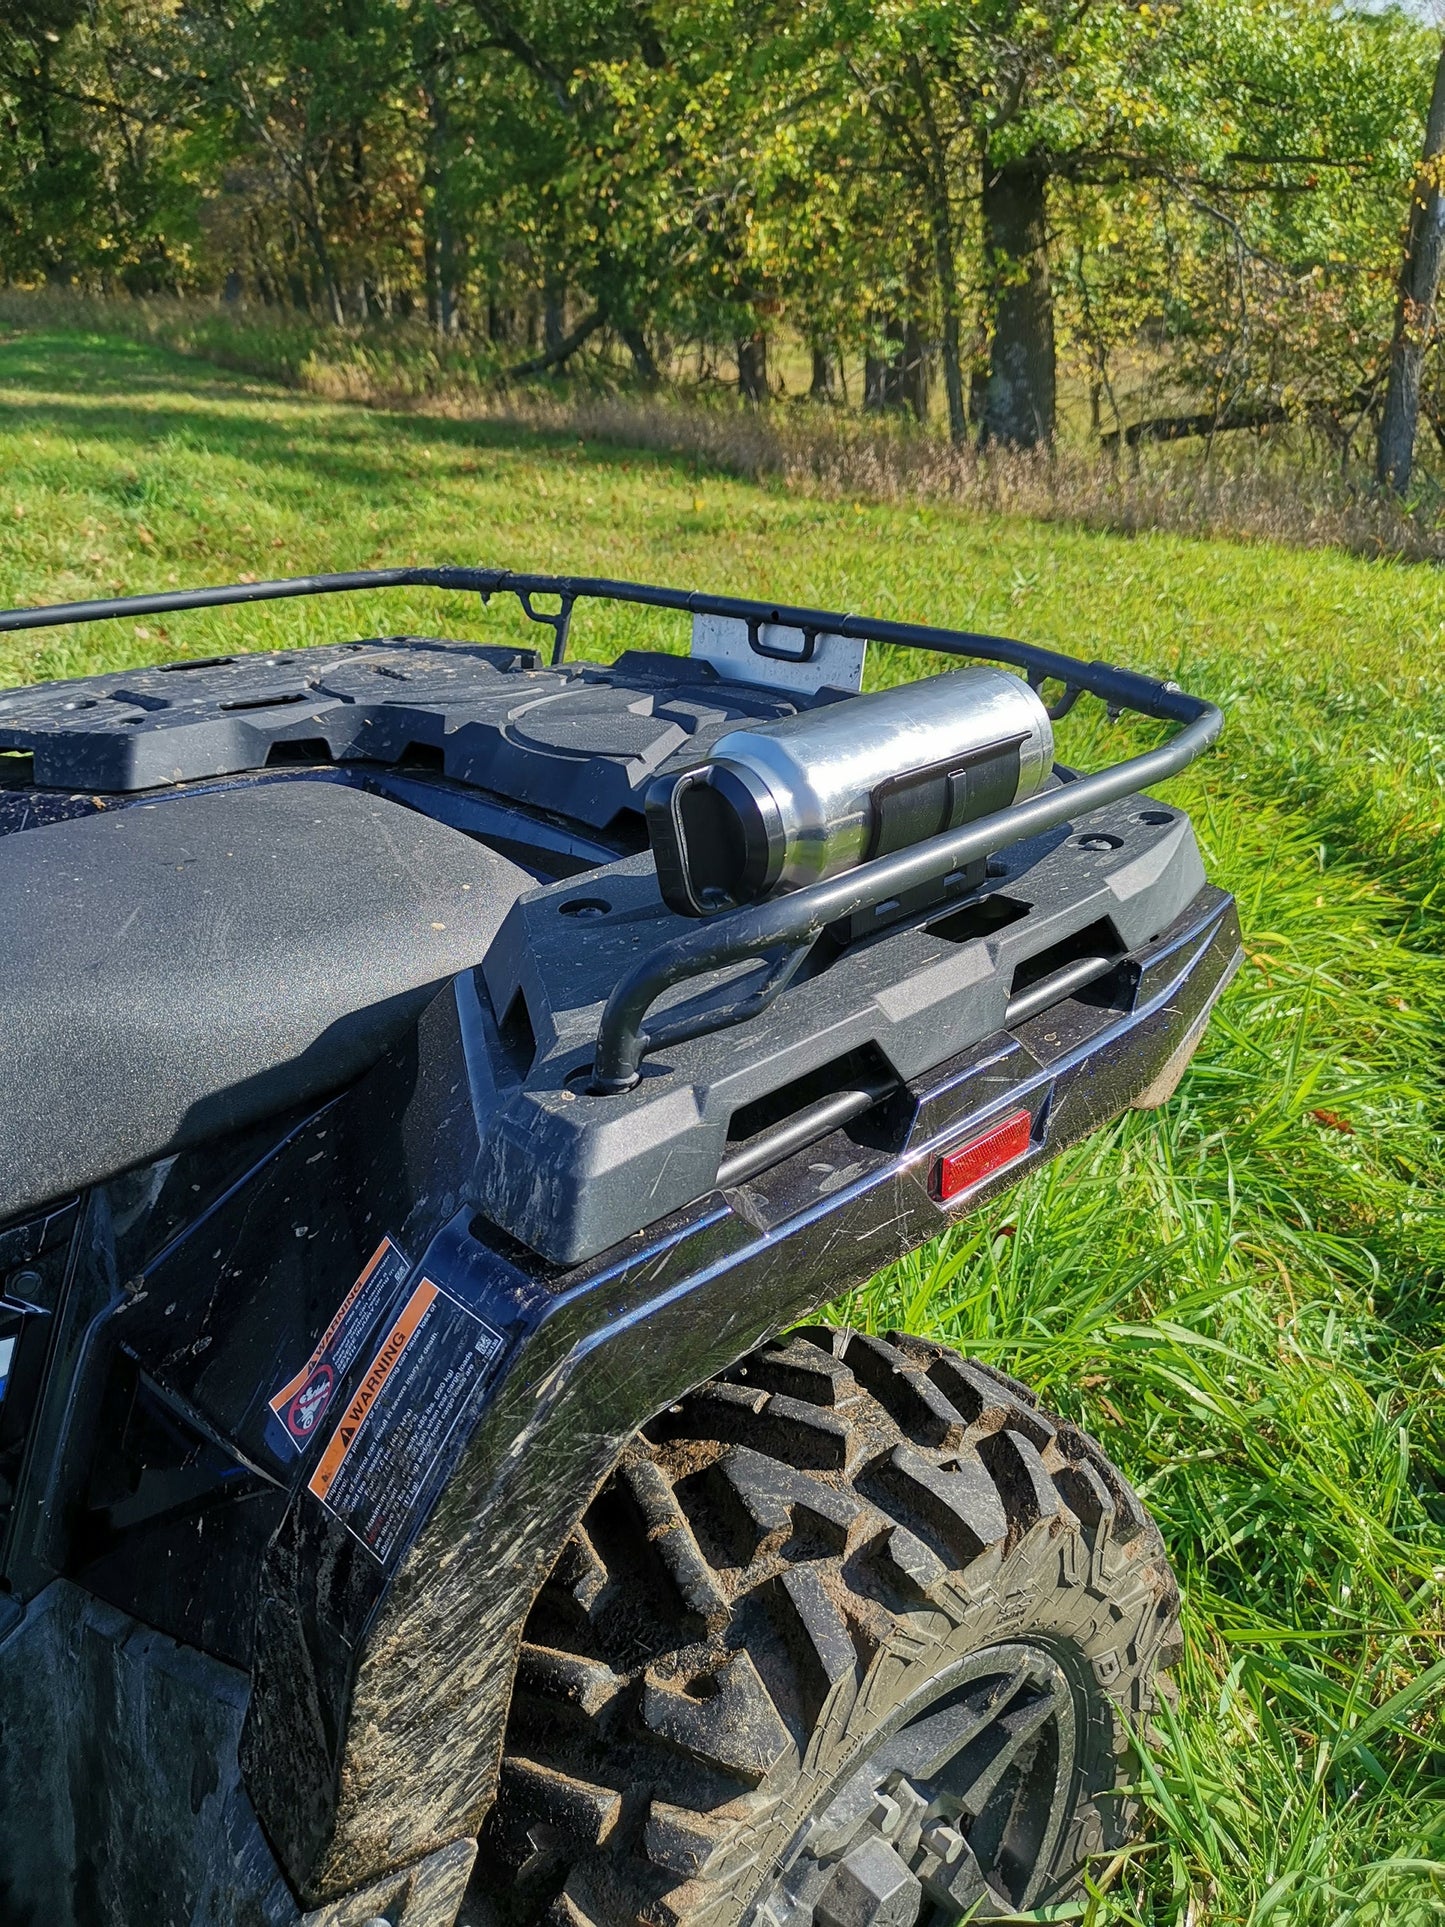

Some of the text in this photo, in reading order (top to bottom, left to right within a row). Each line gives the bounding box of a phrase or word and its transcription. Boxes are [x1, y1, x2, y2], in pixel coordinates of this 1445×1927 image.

[315, 1280, 362, 1357] WARNING
[331, 1316, 359, 1362] Passengers
[357, 1301, 368, 1317] can
[367, 1277, 383, 1302] cause
[333, 1347, 345, 1366] loss
[343, 1337, 351, 1349] of
[366, 1275, 389, 1310] resulting
[387, 1266, 395, 1277] in
[336, 1336, 357, 1371] SEVERE
[355, 1305, 375, 1337] INJURY
[421, 1328, 439, 1356] death.
[416, 1353, 425, 1364] or
[348, 1328, 406, 1424] WARNING
[404, 1362, 420, 1386] injury
[425, 1407, 439, 1430] when
[437, 1392, 448, 1409] rear
[445, 1370, 461, 1394] cargo
[457, 1348, 473, 1372] loads
[326, 1465, 346, 1501] Improper
[343, 1451, 353, 1466] tire
[350, 1418, 371, 1453] pressure
[367, 1408, 376, 1420] or
[397, 1350, 408, 1367] can
[405, 1327, 421, 1352] cause
[419, 1311, 431, 1329] loss
[428, 1302, 437, 1313] of
[390, 1384, 407, 1411] severe
[373, 1417, 388, 1441] result
[385, 1409, 393, 1419] in
[399, 1406, 413, 1428] kPa)
[364, 1490, 387, 1532] Maximum
[416, 1413, 428, 1430] 485
[424, 1398, 436, 1415] lbs.
[433, 1380, 446, 1400] (220
[442, 1367, 454, 1383] kg)
[366, 1440, 377, 1457] can
[373, 1535, 383, 1550] are
[379, 1511, 395, 1537] above
[415, 1436, 432, 1463] and/or
[429, 1417, 443, 1438] front
[440, 1396, 456, 1421] cargo
[464, 1362, 474, 1377] are
[350, 1455, 369, 1485] control
[346, 1492, 360, 1513] Cold
[356, 1478, 367, 1494] tire
[347, 1482, 355, 1494] of
[378, 1530, 394, 1556] above
